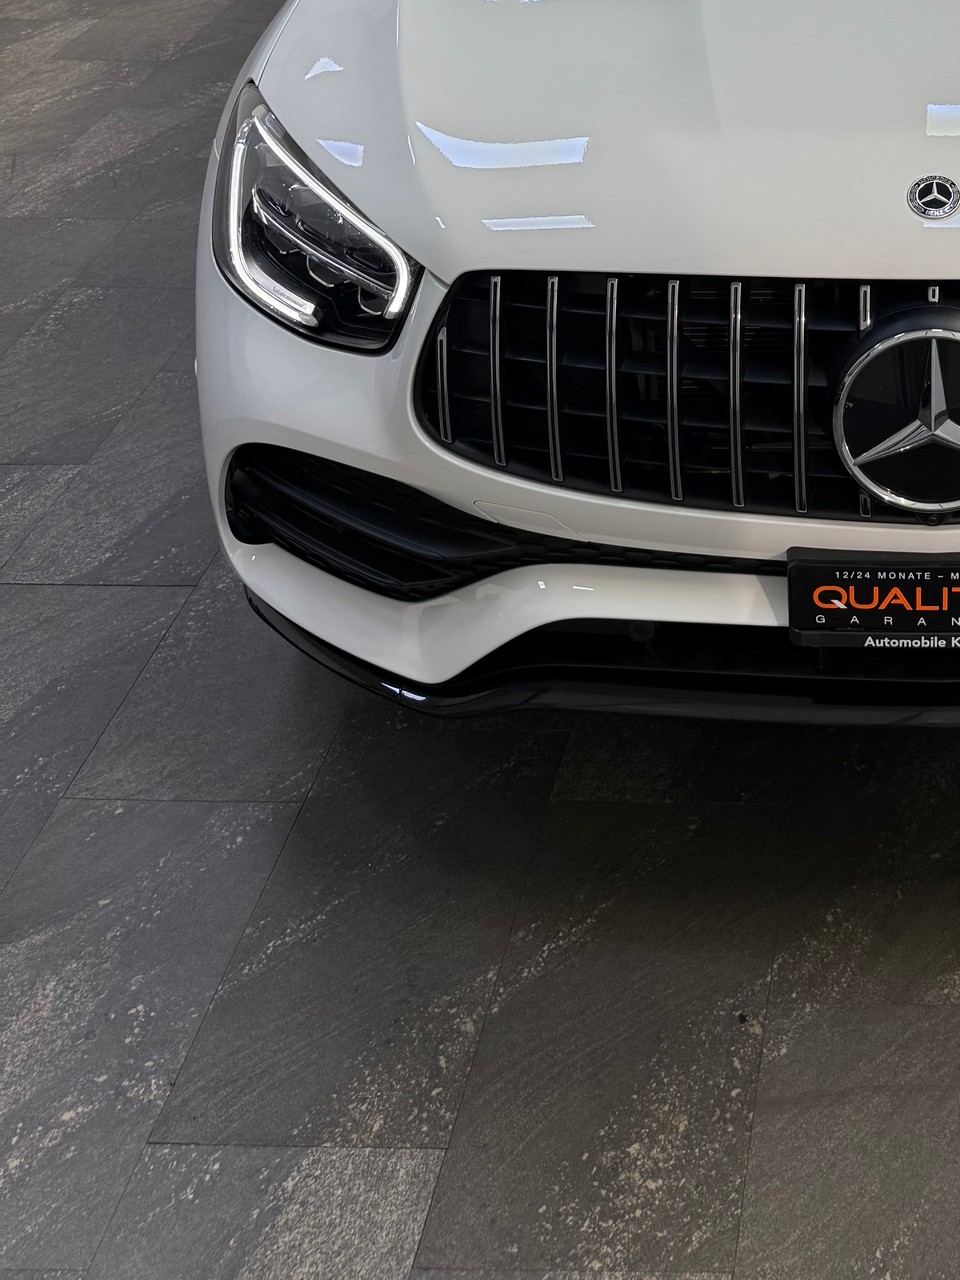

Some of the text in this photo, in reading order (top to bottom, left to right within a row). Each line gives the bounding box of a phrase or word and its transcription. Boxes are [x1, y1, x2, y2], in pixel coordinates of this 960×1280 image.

[835, 571, 870, 580] 12/24
[877, 572, 930, 580] MONATE
[864, 636, 946, 647] Automobile
